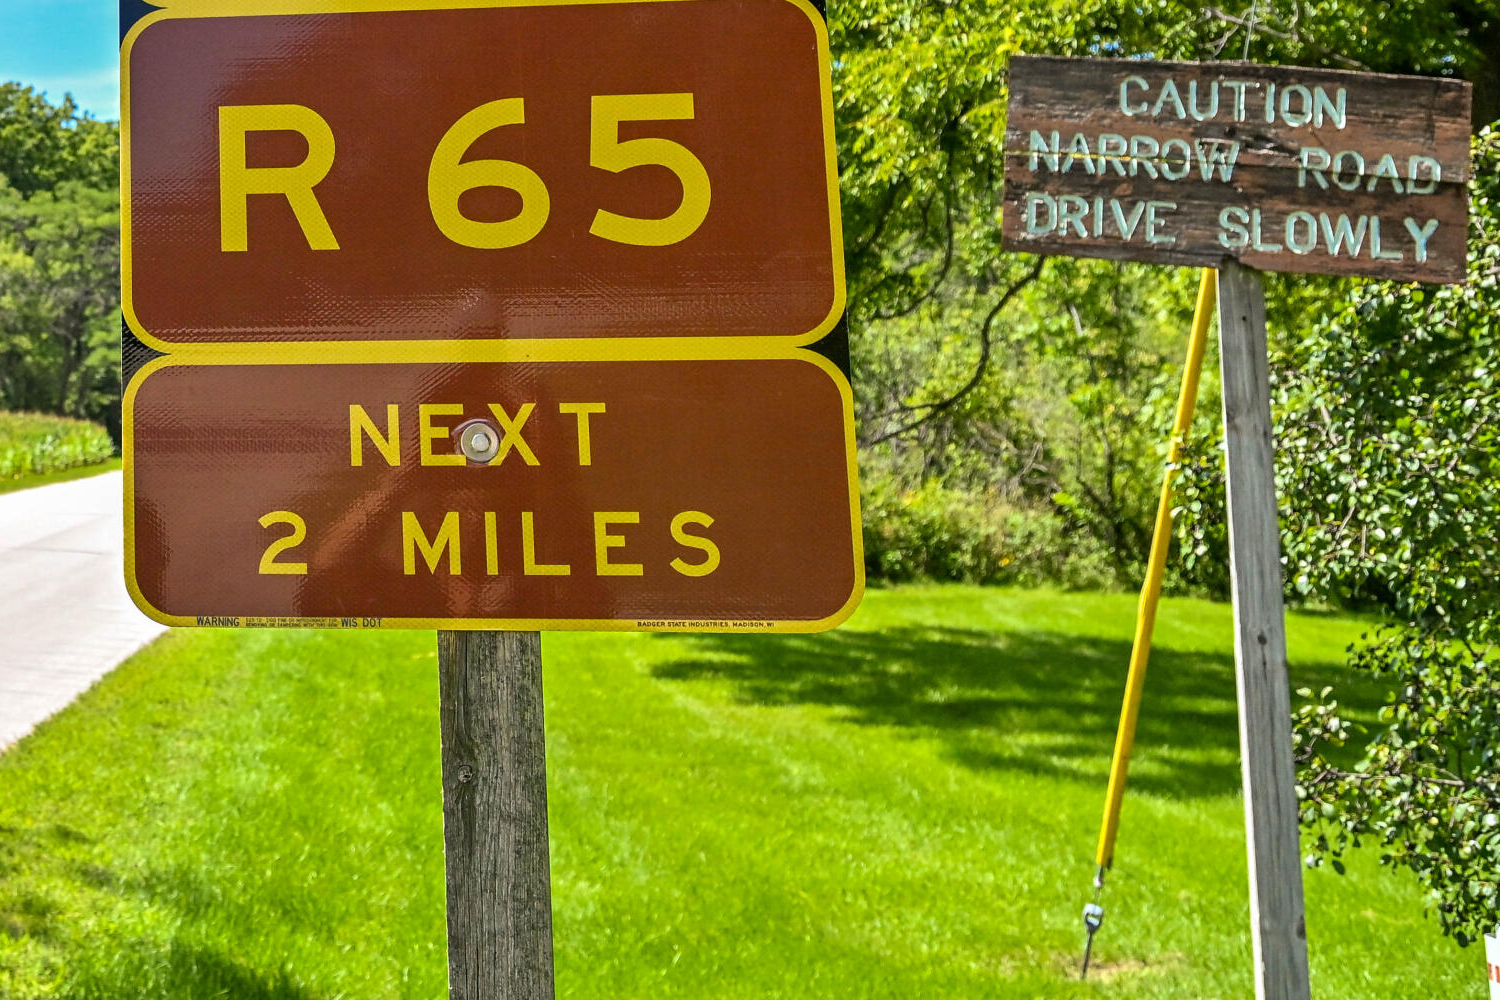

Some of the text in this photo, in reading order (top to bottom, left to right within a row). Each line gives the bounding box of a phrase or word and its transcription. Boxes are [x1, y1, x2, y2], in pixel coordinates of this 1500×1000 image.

[1118, 76, 1347, 130] CAUTION
[218, 93, 711, 252] R 65
[1028, 130, 1442, 195] NARROW ROAD
[1025, 192, 1439, 264] DRIVE SLOWLY
[349, 402, 606, 467] NEXT
[257, 510, 721, 577] 2 MILES
[196, 616, 240, 627] WARNING
[362, 617, 382, 628] DOT
